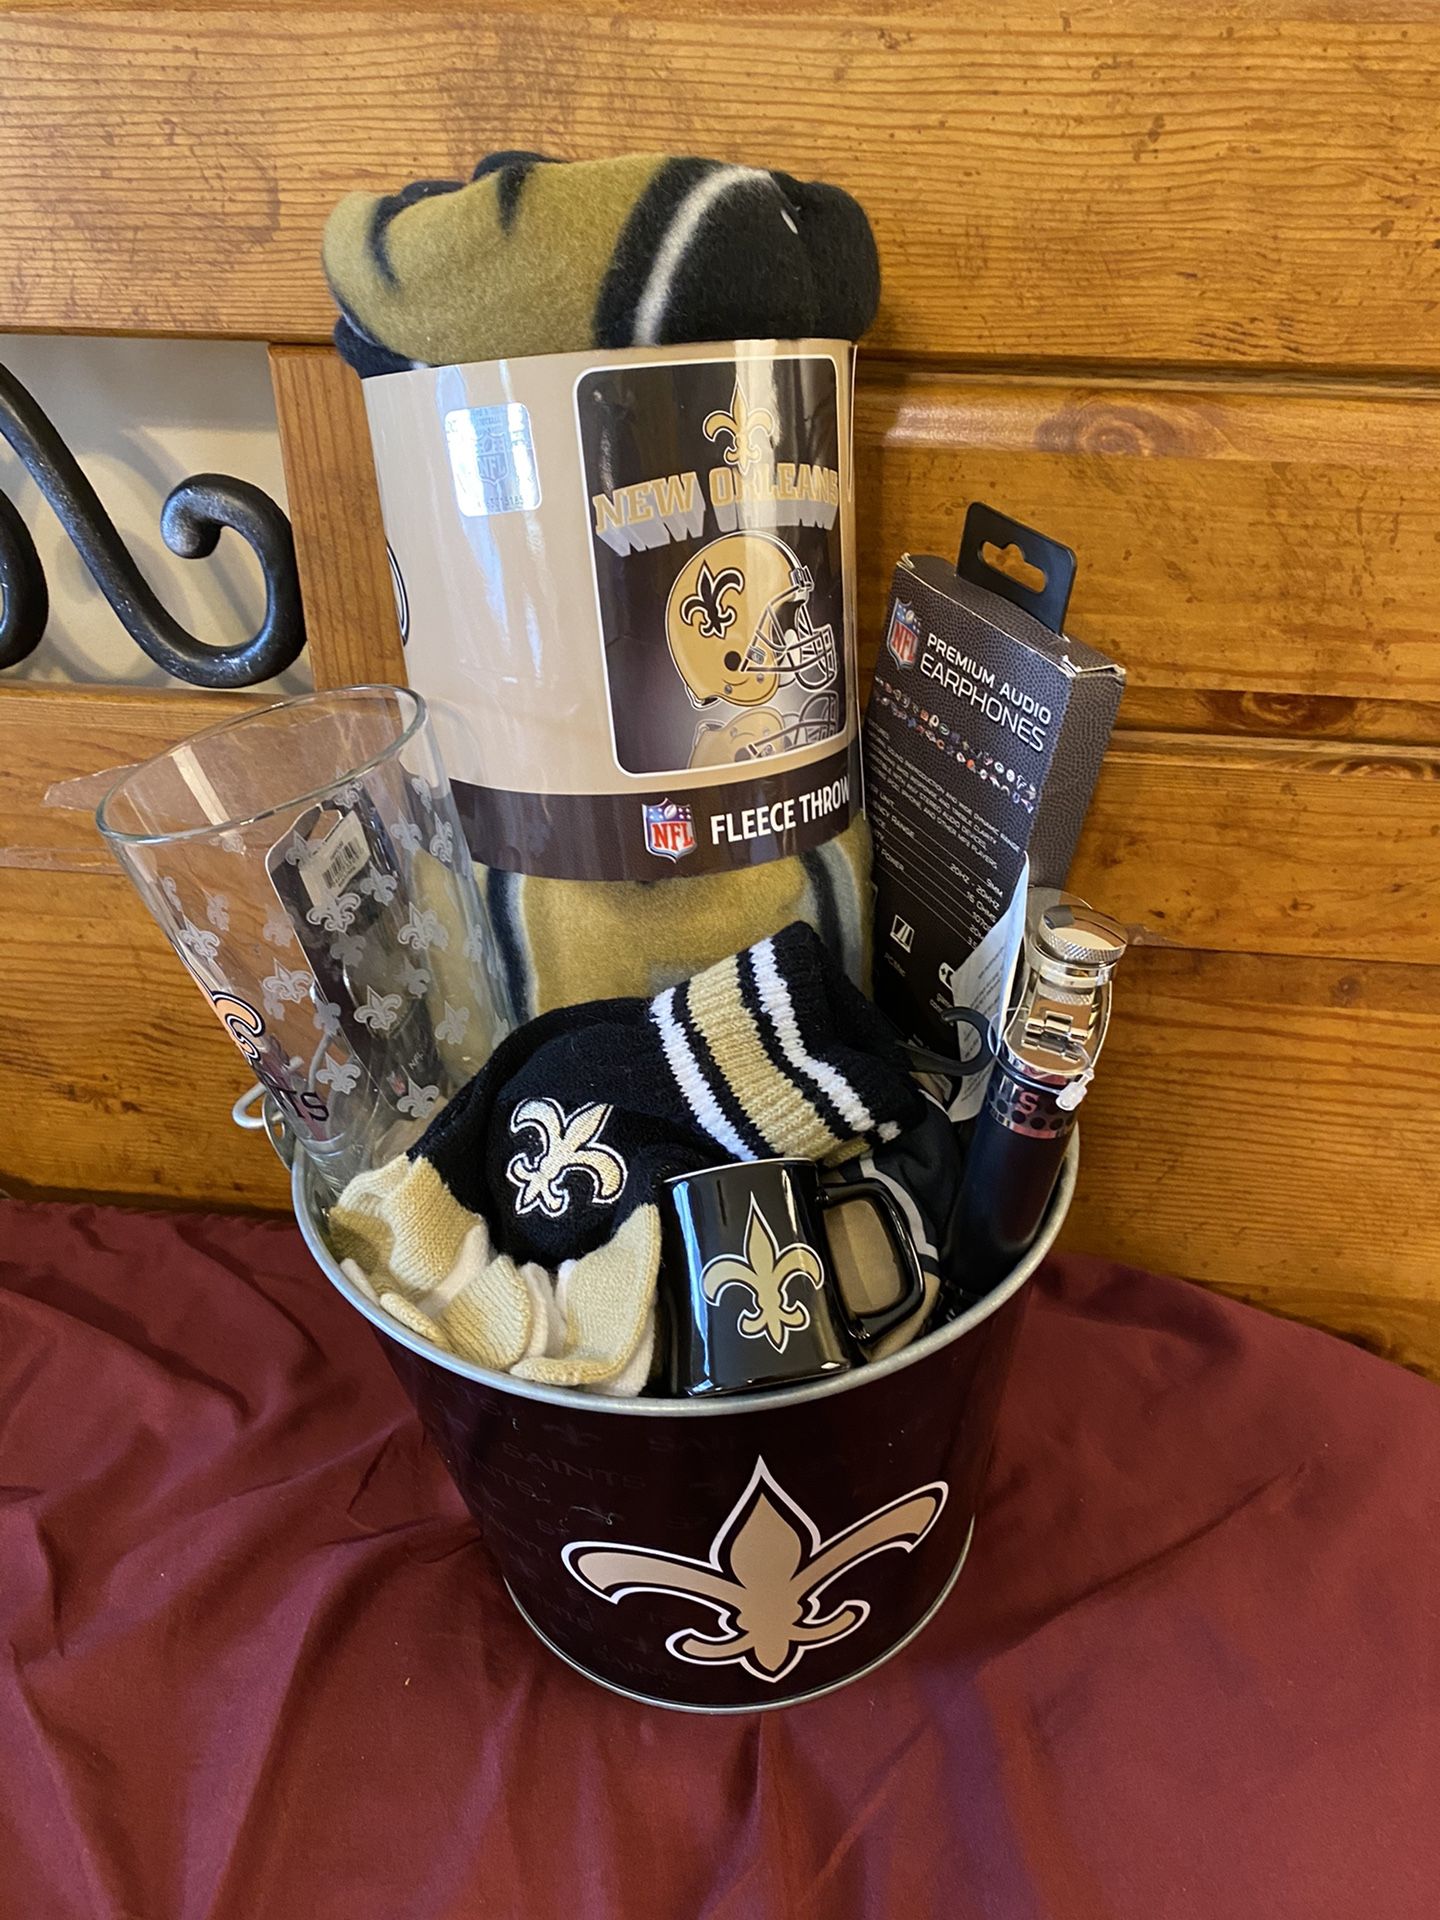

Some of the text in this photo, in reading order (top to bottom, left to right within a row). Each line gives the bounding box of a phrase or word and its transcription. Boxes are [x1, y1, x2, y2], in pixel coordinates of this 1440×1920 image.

[592, 462, 839, 538] NEW ORLEANS
[892, 622, 918, 662] NFL
[919, 653, 1047, 753] EARPHONES
[926, 632, 1051, 725] PREMIUM AUDIO
[652, 820, 694, 851] NFL
[709, 774, 850, 846] FLEECE THROW
[500, 1440, 648, 1490] SAINTS
